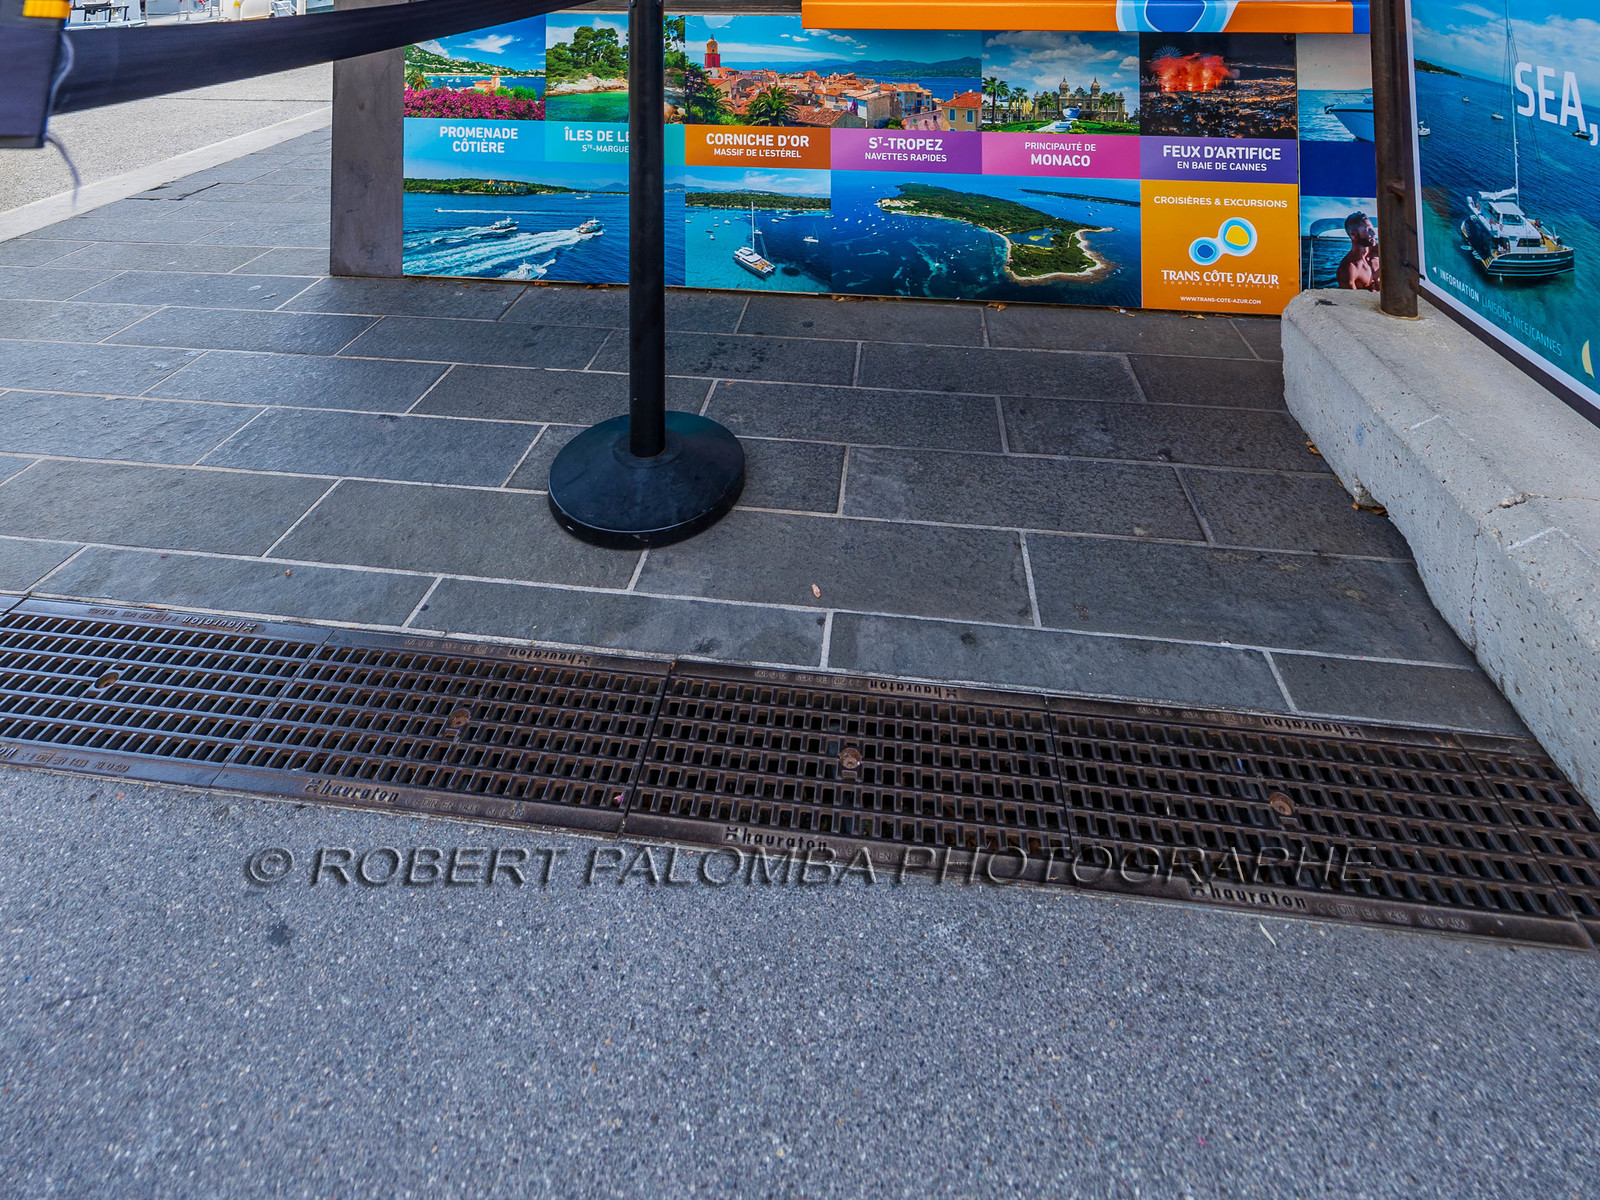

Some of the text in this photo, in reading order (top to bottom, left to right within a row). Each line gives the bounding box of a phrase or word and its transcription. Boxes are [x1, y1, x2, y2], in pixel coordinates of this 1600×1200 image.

[1515, 62, 1599, 146] SEA,
[440, 126, 519, 140] PROMENADE
[564, 126, 593, 141] ÎLES
[597, 130, 613, 142] DE
[706, 133, 774, 146] CORNICHE
[452, 139, 505, 154] CÔTIÈRE
[868, 136, 943, 151] ST-TROPEZ
[1025, 141, 1096, 152] PRINCIPAUTÉ DE
[714, 148, 744, 157] MASSIF
[746, 149, 757, 157] DE
[865, 152, 947, 163] NAVETTES RAPIDES
[1163, 145, 1200, 158] FEUX
[1031, 153, 1091, 167] MONACO
[1177, 161, 1267, 172] EN BAIE DE CANNES
[1154, 195, 1288, 208] CROISIÈRES & EXCURSIONS
[1161, 269, 1200, 281] TRANS
[1203, 269, 1233, 283] CÔTE
[1180, 296, 1262, 305] WWW.TRANS-COTE-AZUR.COM
[1440, 270, 1562, 357] INFORMATION LIAISONS NICE/CANNES
[509, 647, 577, 665] hauraton
[869, 680, 942, 698] hauraton
[1262, 716, 1346, 737] hauraton
[320, 779, 400, 803] hauraton
[743, 827, 828, 852] hauraton
[1211, 882, 1307, 909] hauraton
